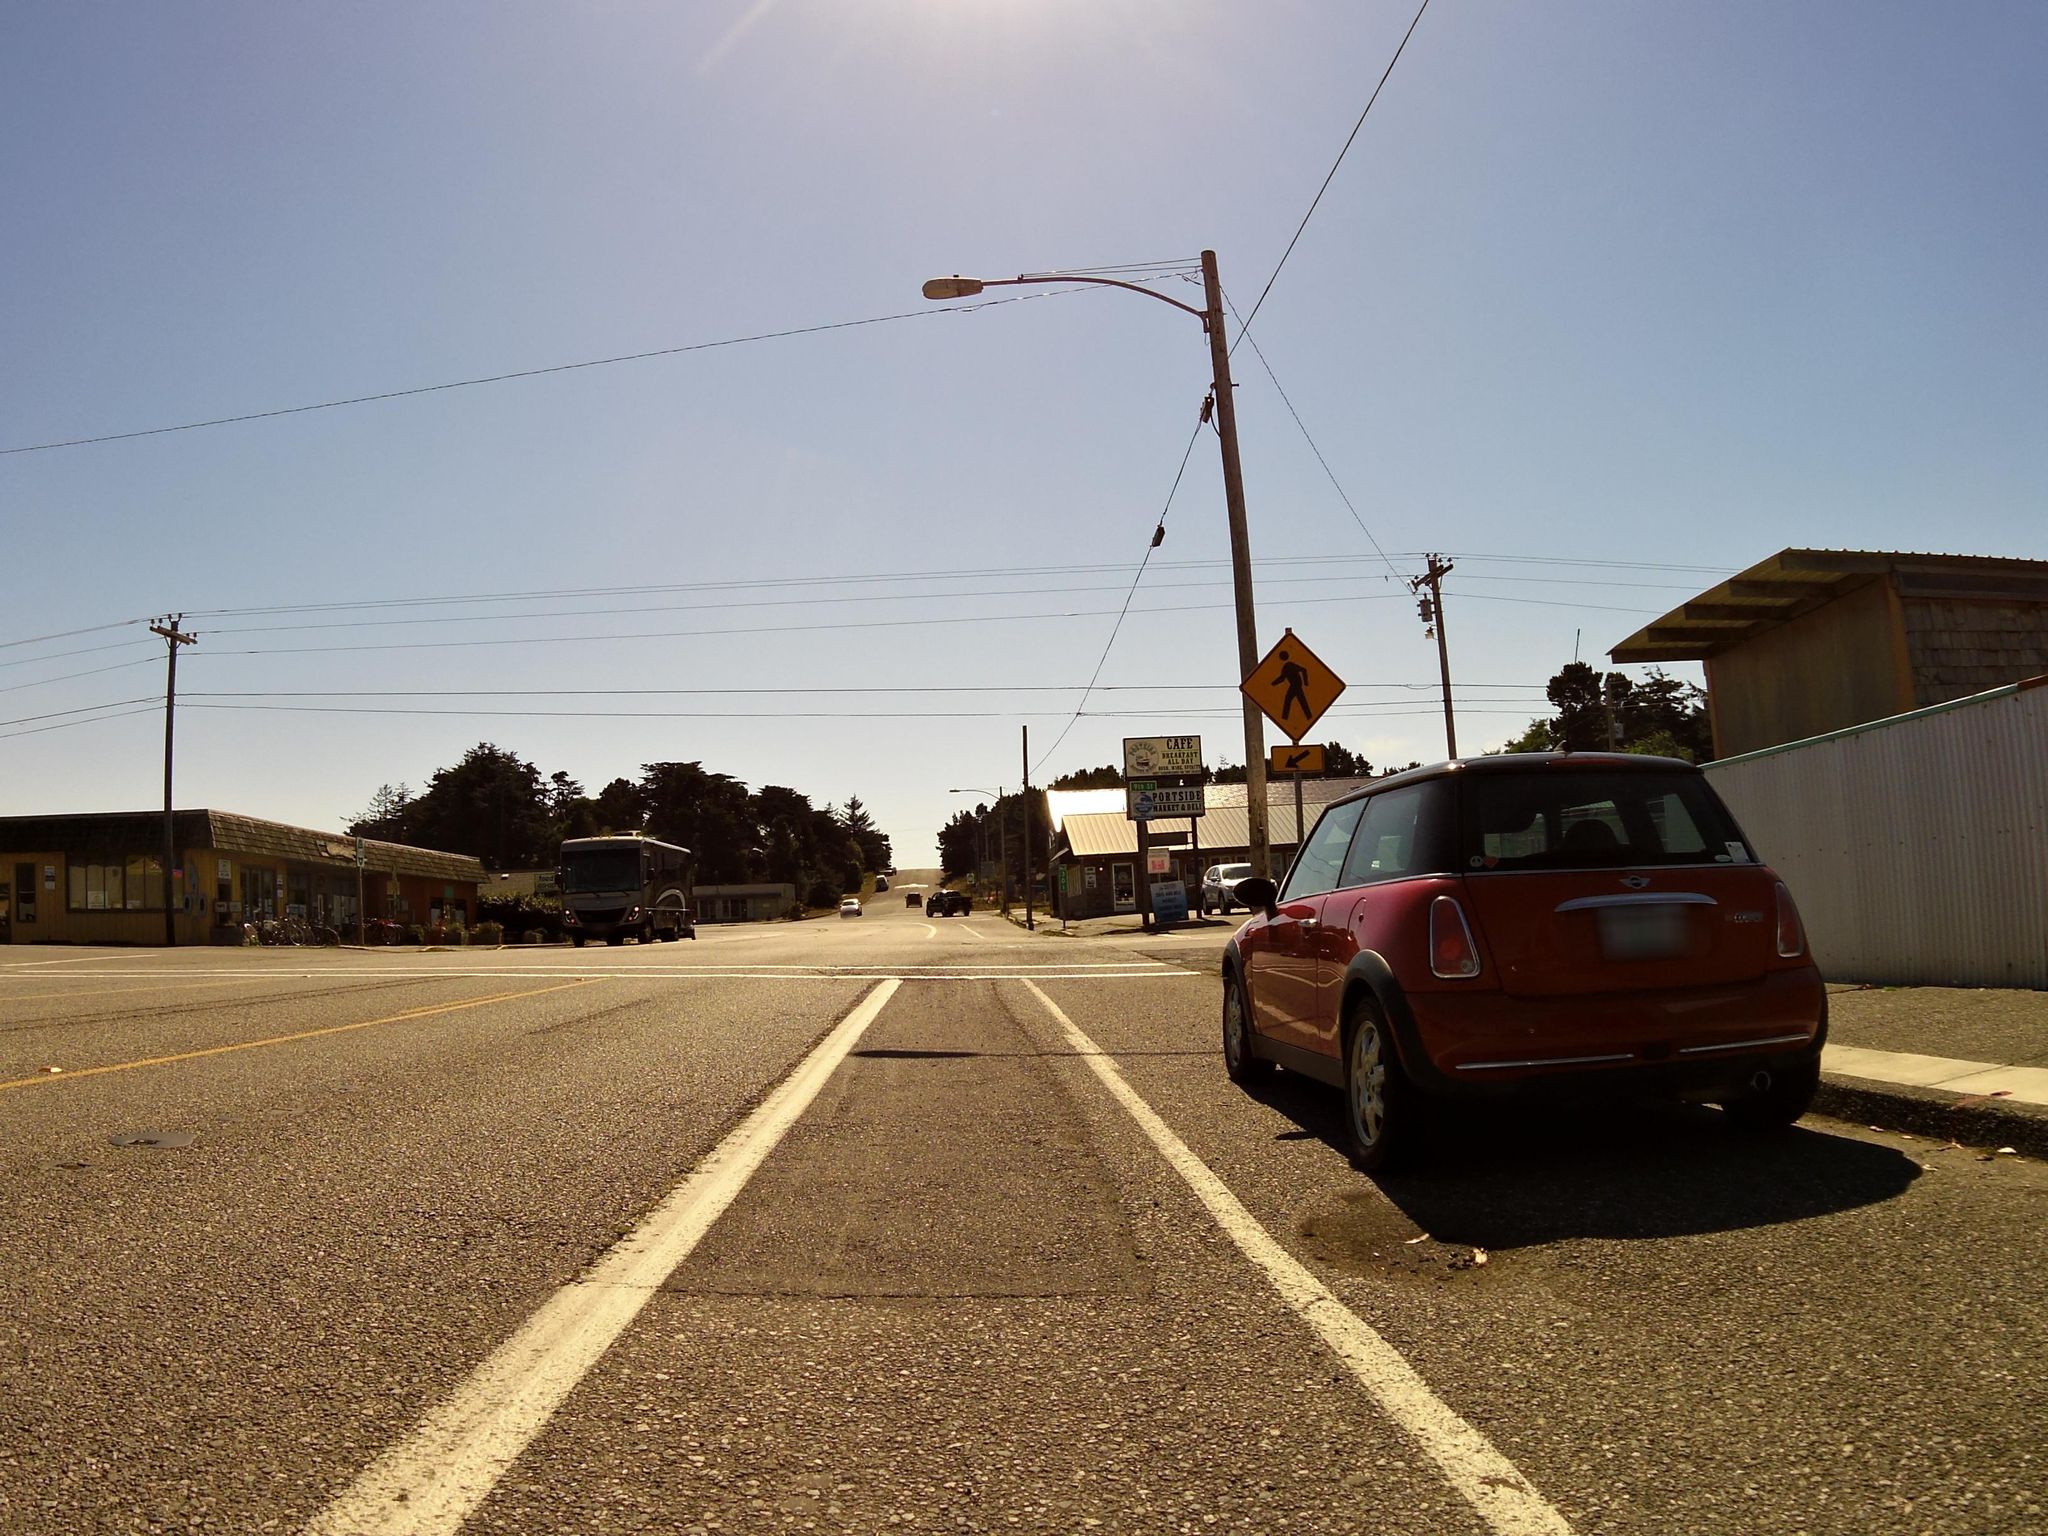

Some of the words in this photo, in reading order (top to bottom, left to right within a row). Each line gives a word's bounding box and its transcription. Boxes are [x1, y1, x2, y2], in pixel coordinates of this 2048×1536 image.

[1166, 738, 1193, 750] CAFE
[1152, 790, 1201, 802] PORTSIDE
[1153, 804, 1180, 812] MARKET
[1187, 803, 1202, 811] DELI
